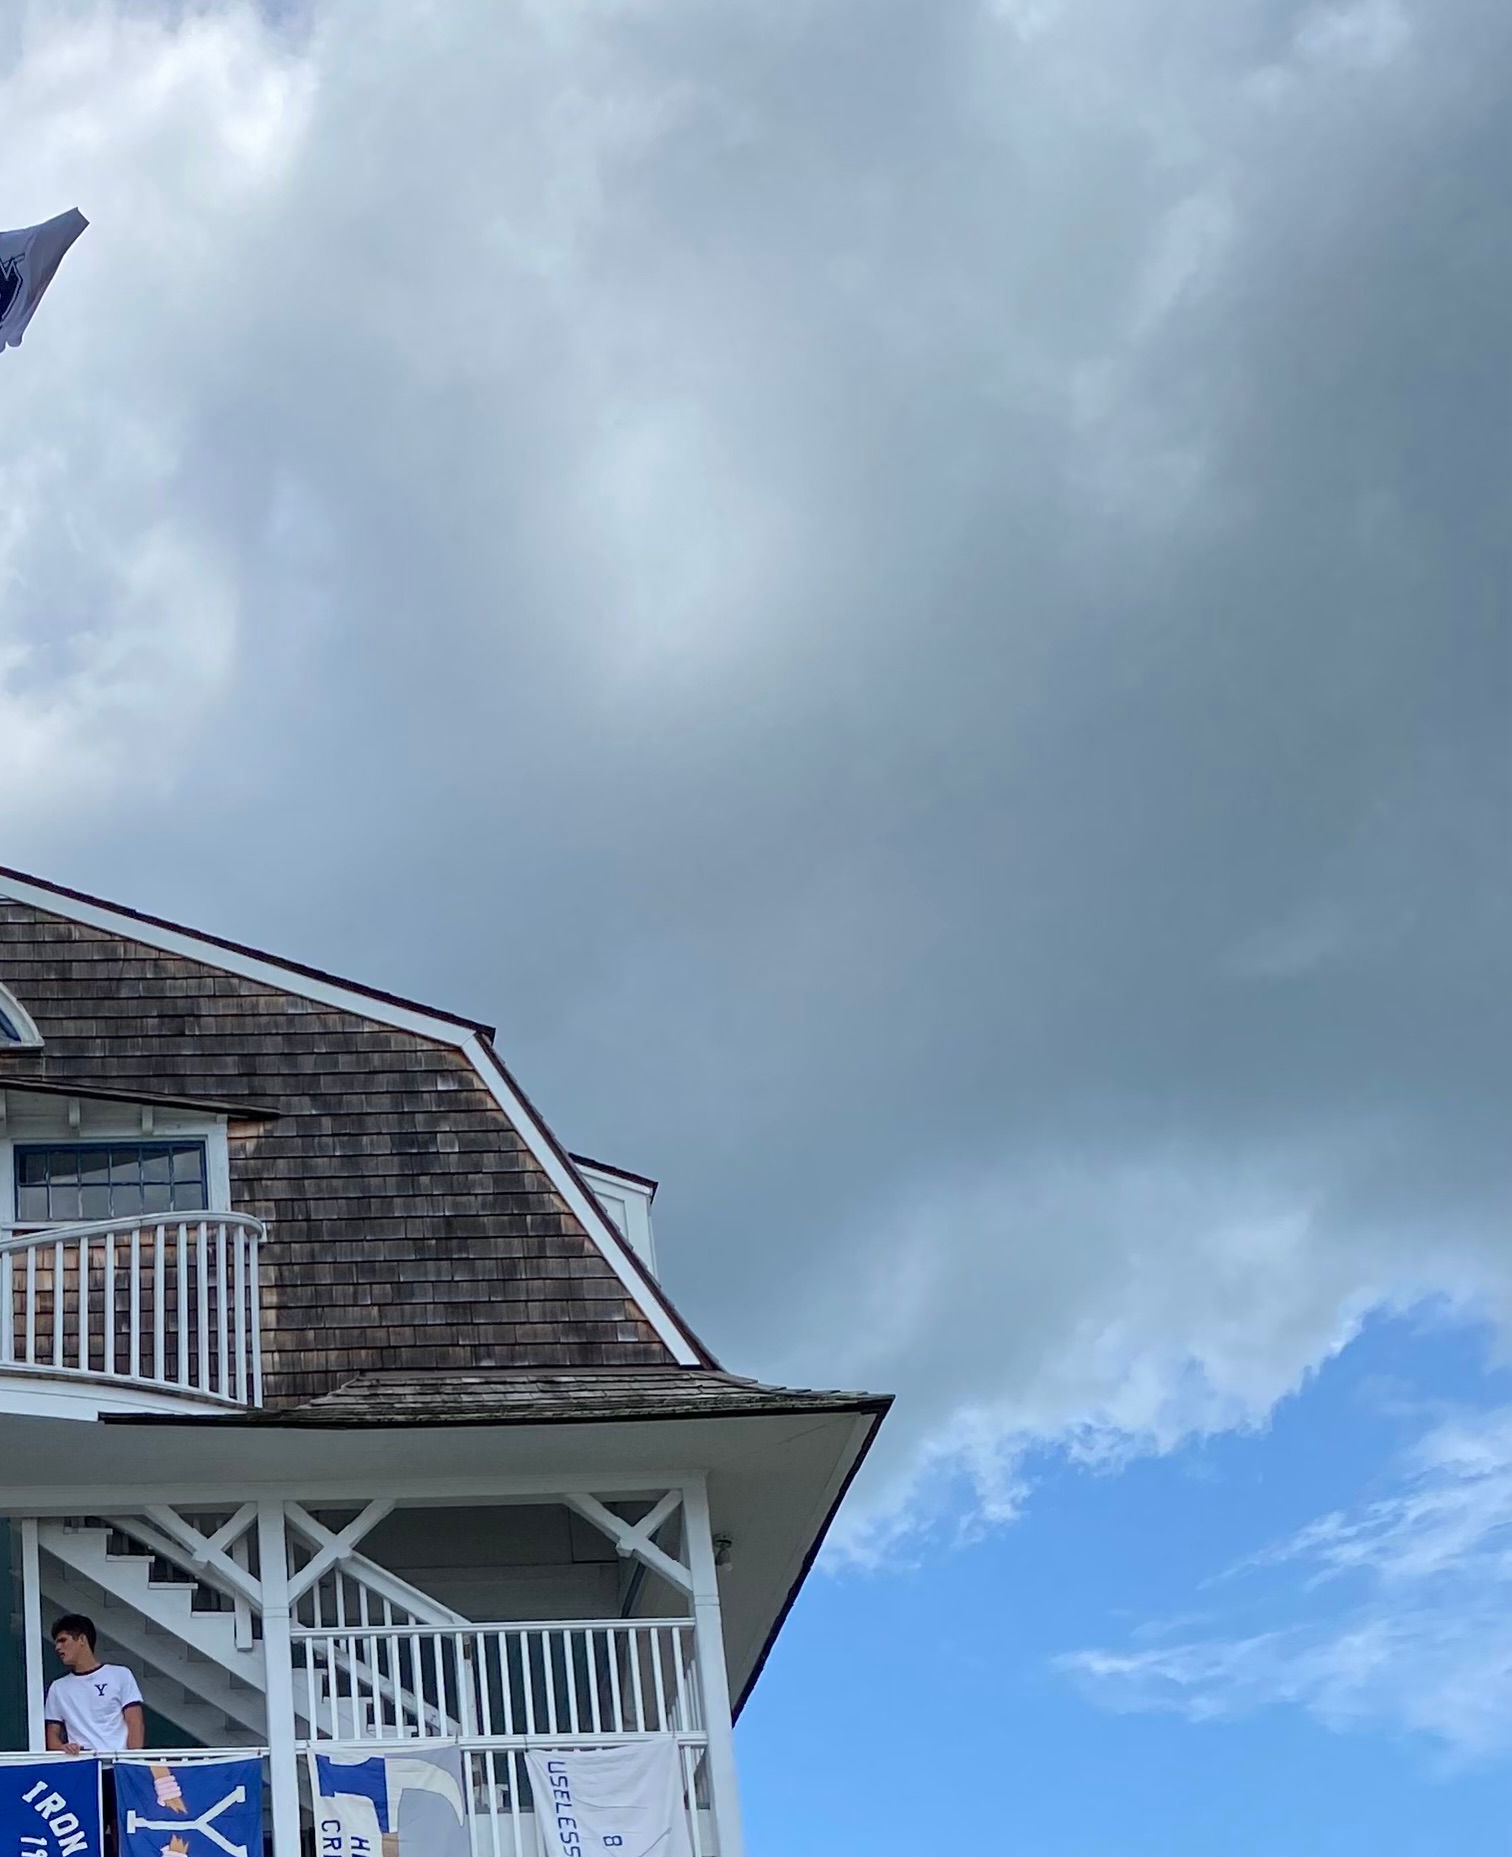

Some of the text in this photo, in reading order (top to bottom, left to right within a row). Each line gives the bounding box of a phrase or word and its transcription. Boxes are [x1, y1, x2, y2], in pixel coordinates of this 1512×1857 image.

[94, 1682, 108, 1697] Y
[22, 1780, 88, 1857] IRON
[548, 1761, 582, 1857] USELESS
